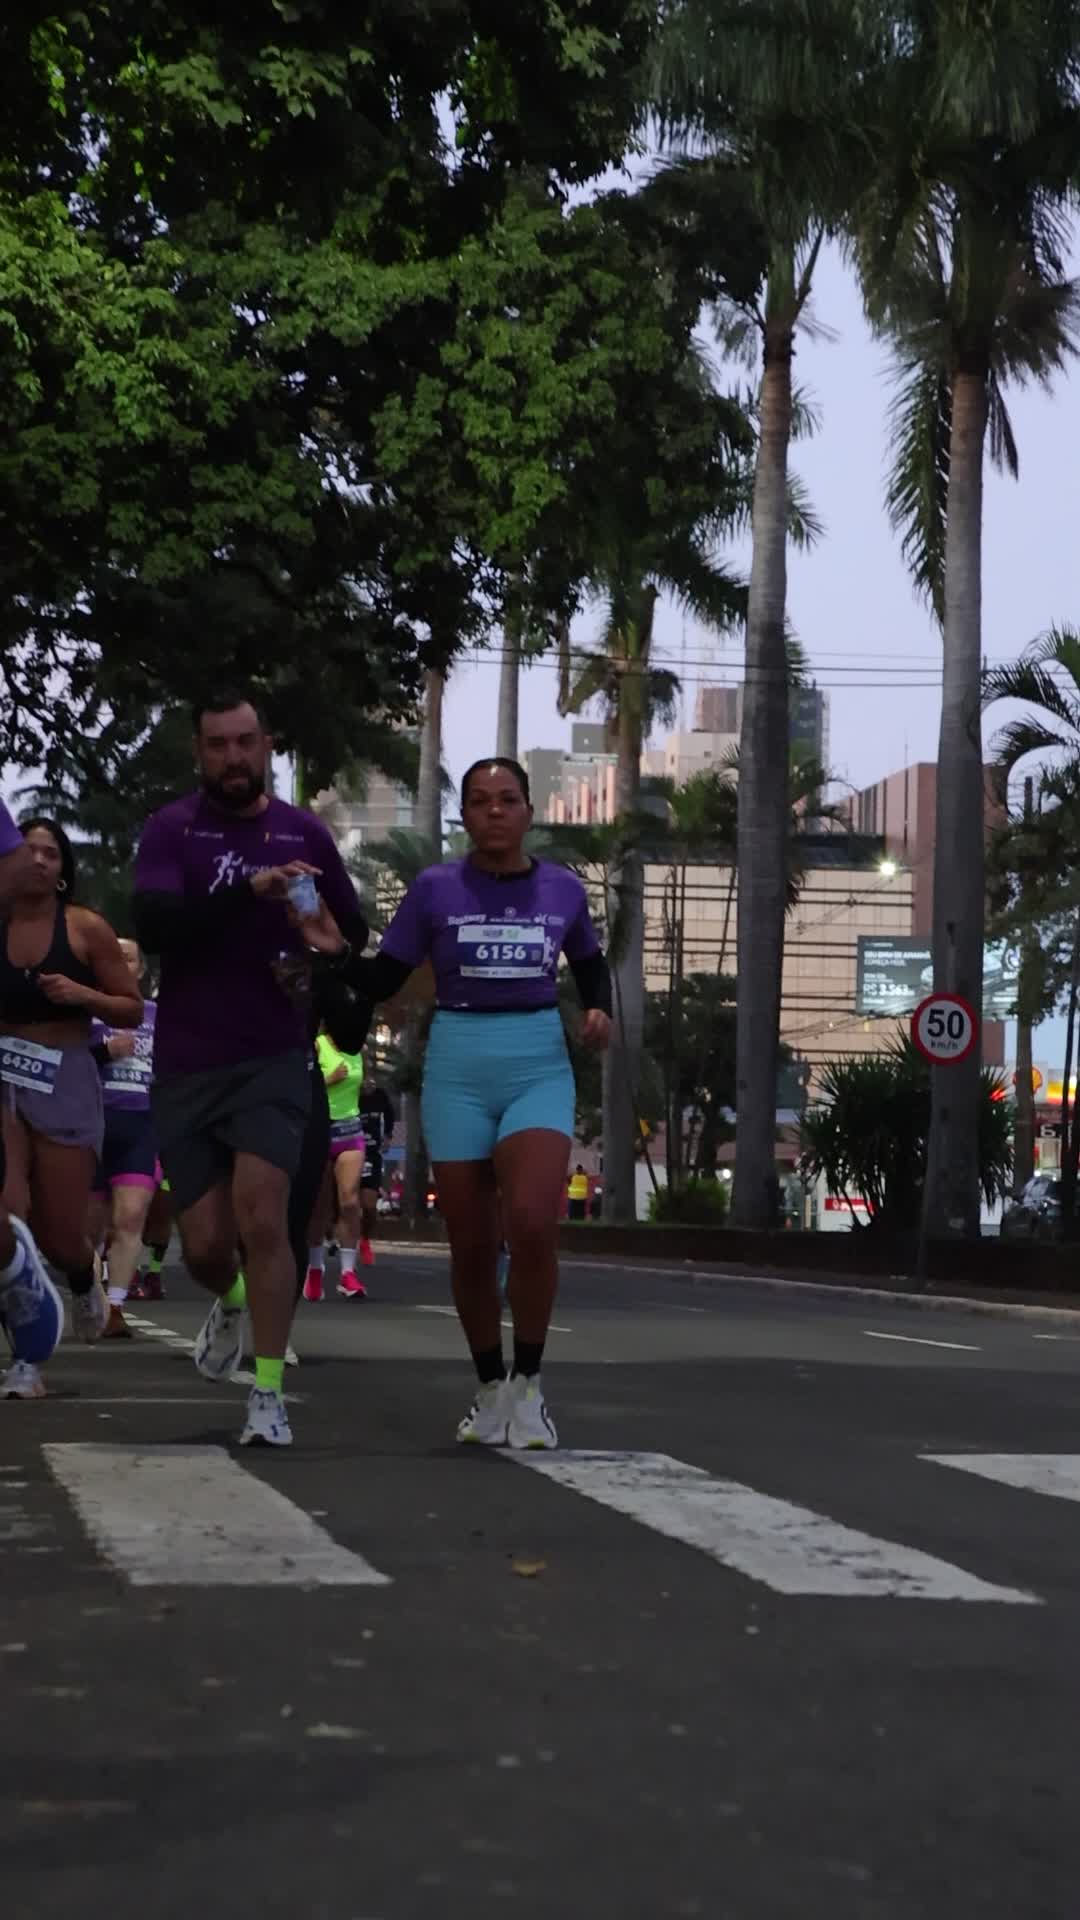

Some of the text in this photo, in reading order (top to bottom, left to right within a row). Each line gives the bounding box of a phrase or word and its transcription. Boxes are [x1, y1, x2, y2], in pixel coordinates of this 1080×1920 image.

[476, 945, 527, 960] 6156
[927, 1008, 965, 1040] 50
[931, 1040, 959, 1050] km/h
[2, 1053, 43, 1074] 6420
